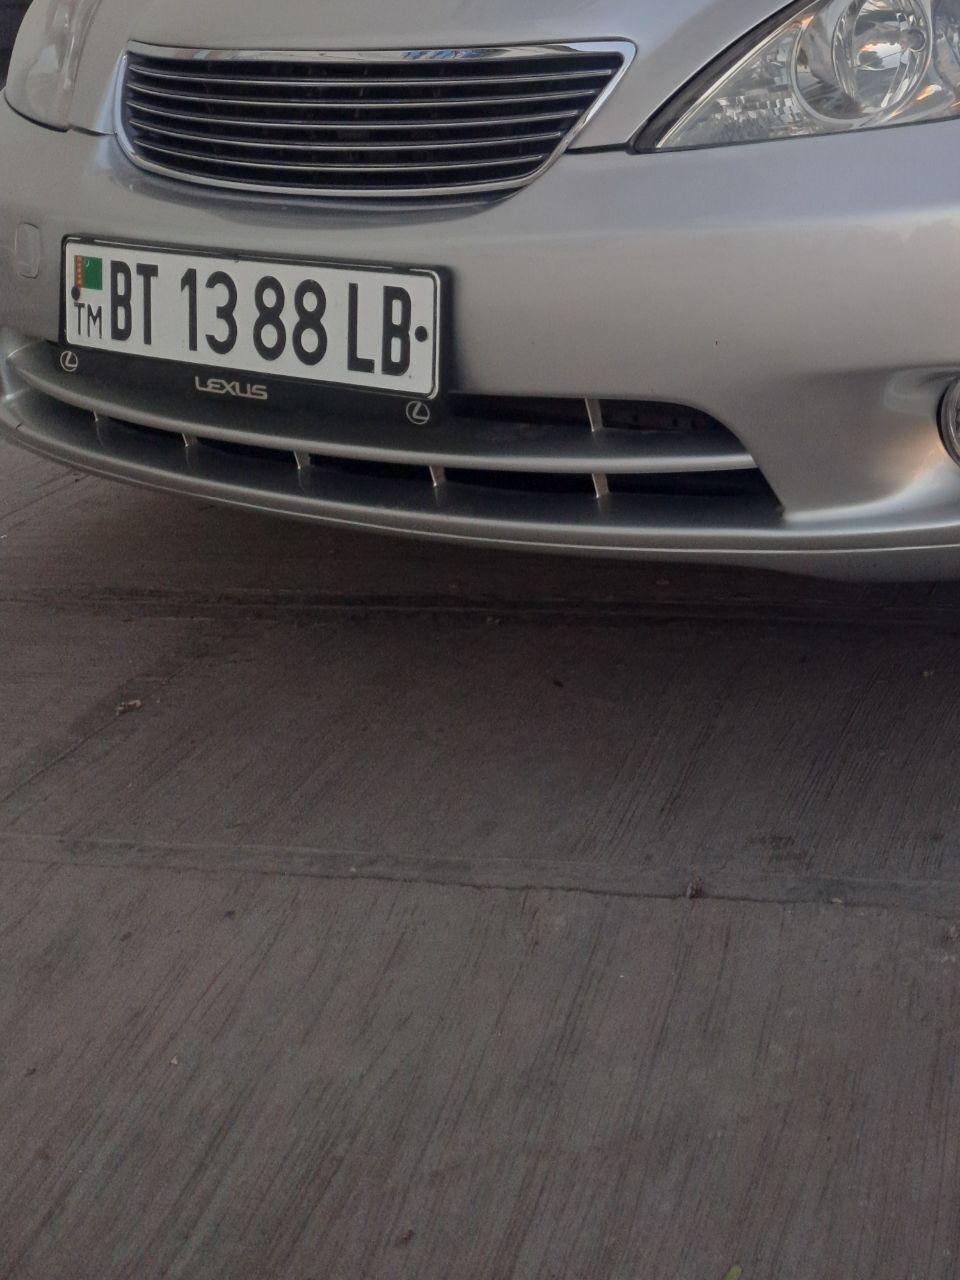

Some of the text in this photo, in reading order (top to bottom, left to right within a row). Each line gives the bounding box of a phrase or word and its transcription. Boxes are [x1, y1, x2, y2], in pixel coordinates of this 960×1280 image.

[74, 302, 103, 340] TM
[110, 259, 412, 377] BT 1388 LB
[194, 375, 269, 401] LEXUS
